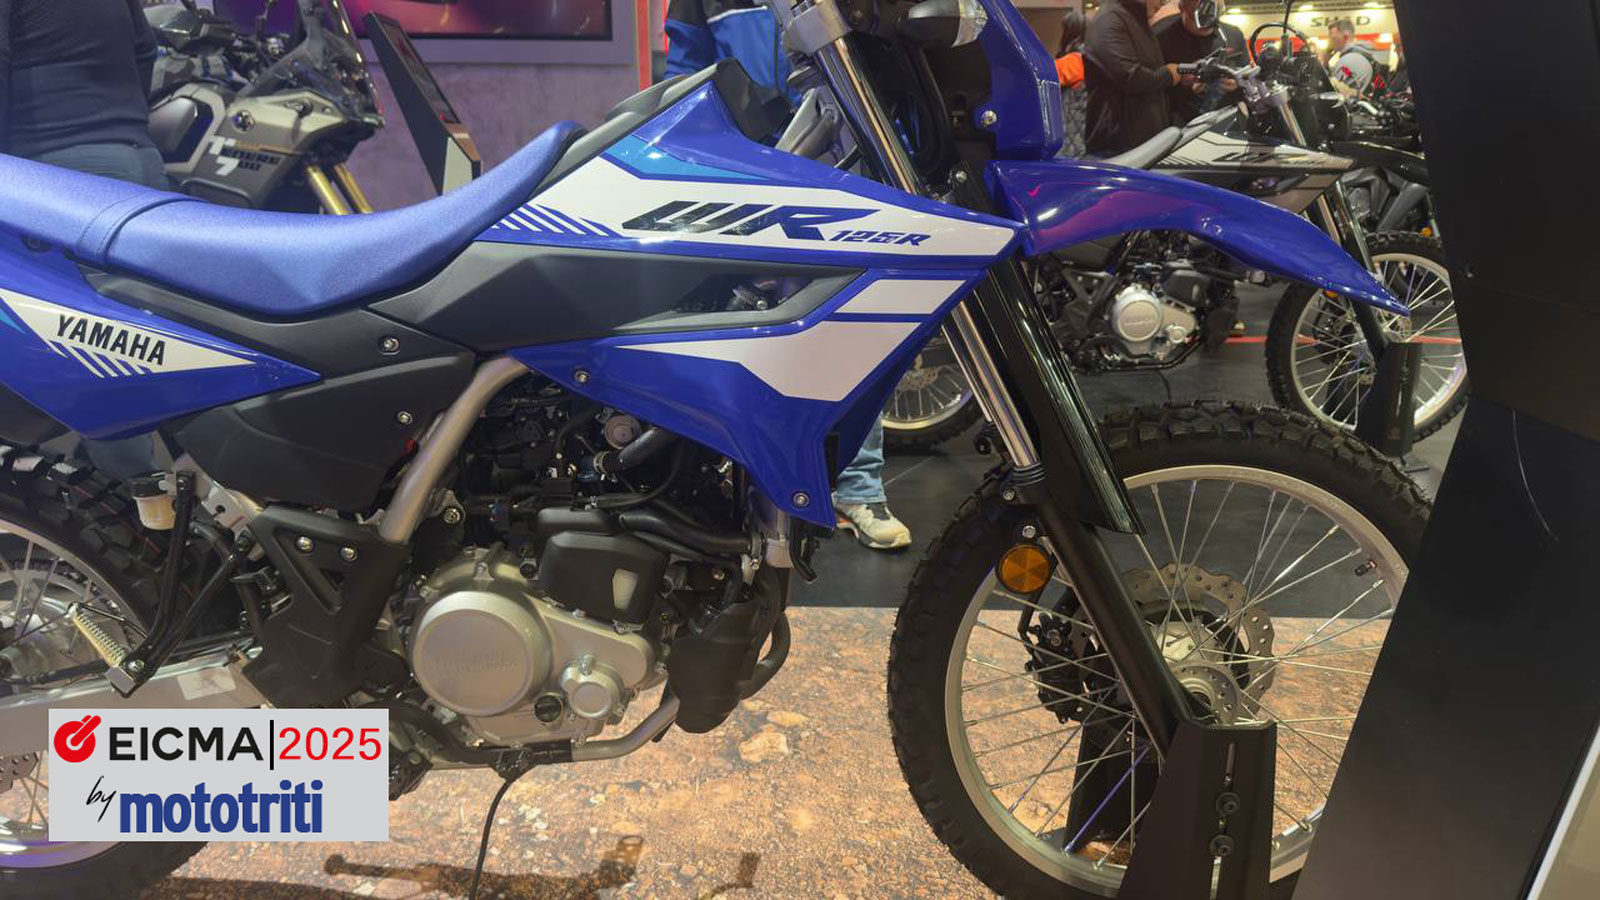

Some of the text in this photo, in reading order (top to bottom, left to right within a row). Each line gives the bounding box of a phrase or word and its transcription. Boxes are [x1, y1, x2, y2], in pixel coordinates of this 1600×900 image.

[1311, 16, 1371, 27] SHD
[621, 200, 931, 246] WR 125R
[56, 314, 168, 366] YAMAHA
